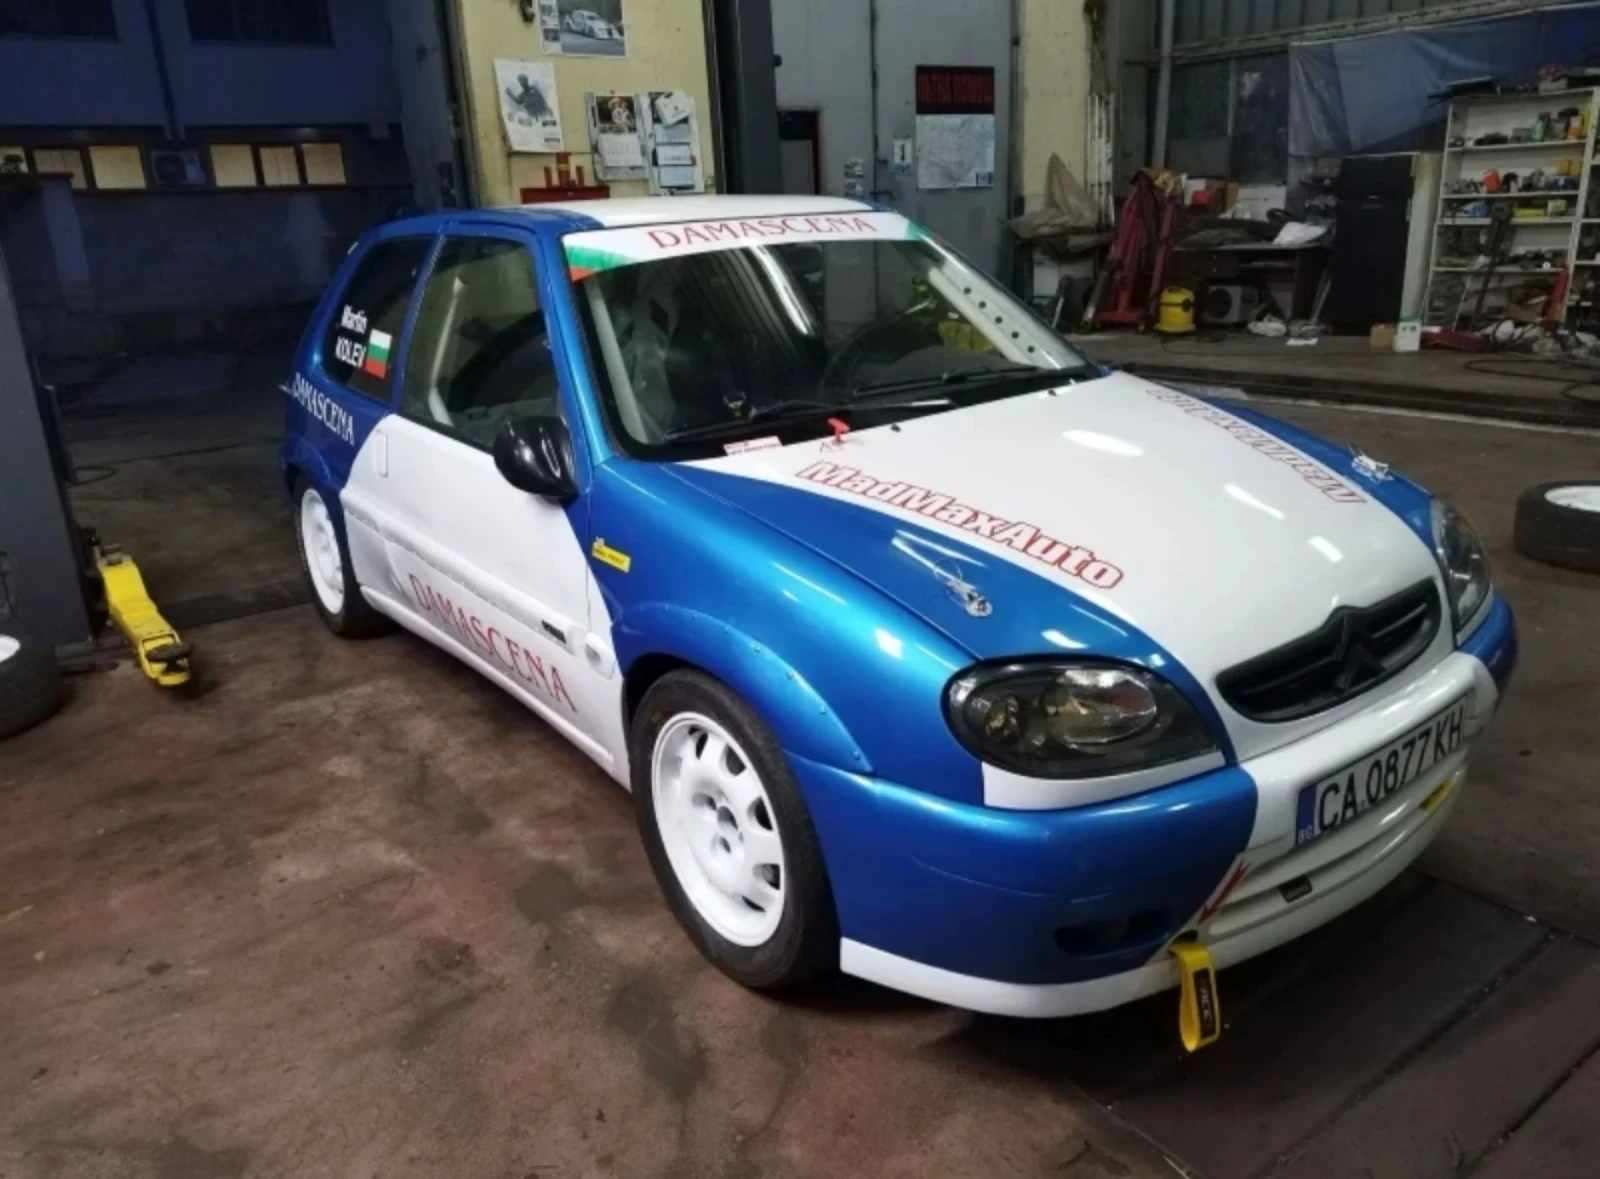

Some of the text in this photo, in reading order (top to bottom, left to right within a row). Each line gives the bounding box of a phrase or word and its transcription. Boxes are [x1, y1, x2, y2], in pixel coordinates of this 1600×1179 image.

[647, 216, 878, 249] DAMASCENA
[335, 336, 366, 368] KOLEV
[292, 372, 355, 446] DAMASCENA
[795, 460, 1125, 590] MadMaxAuto
[408, 573, 578, 714] DAMASCENA
